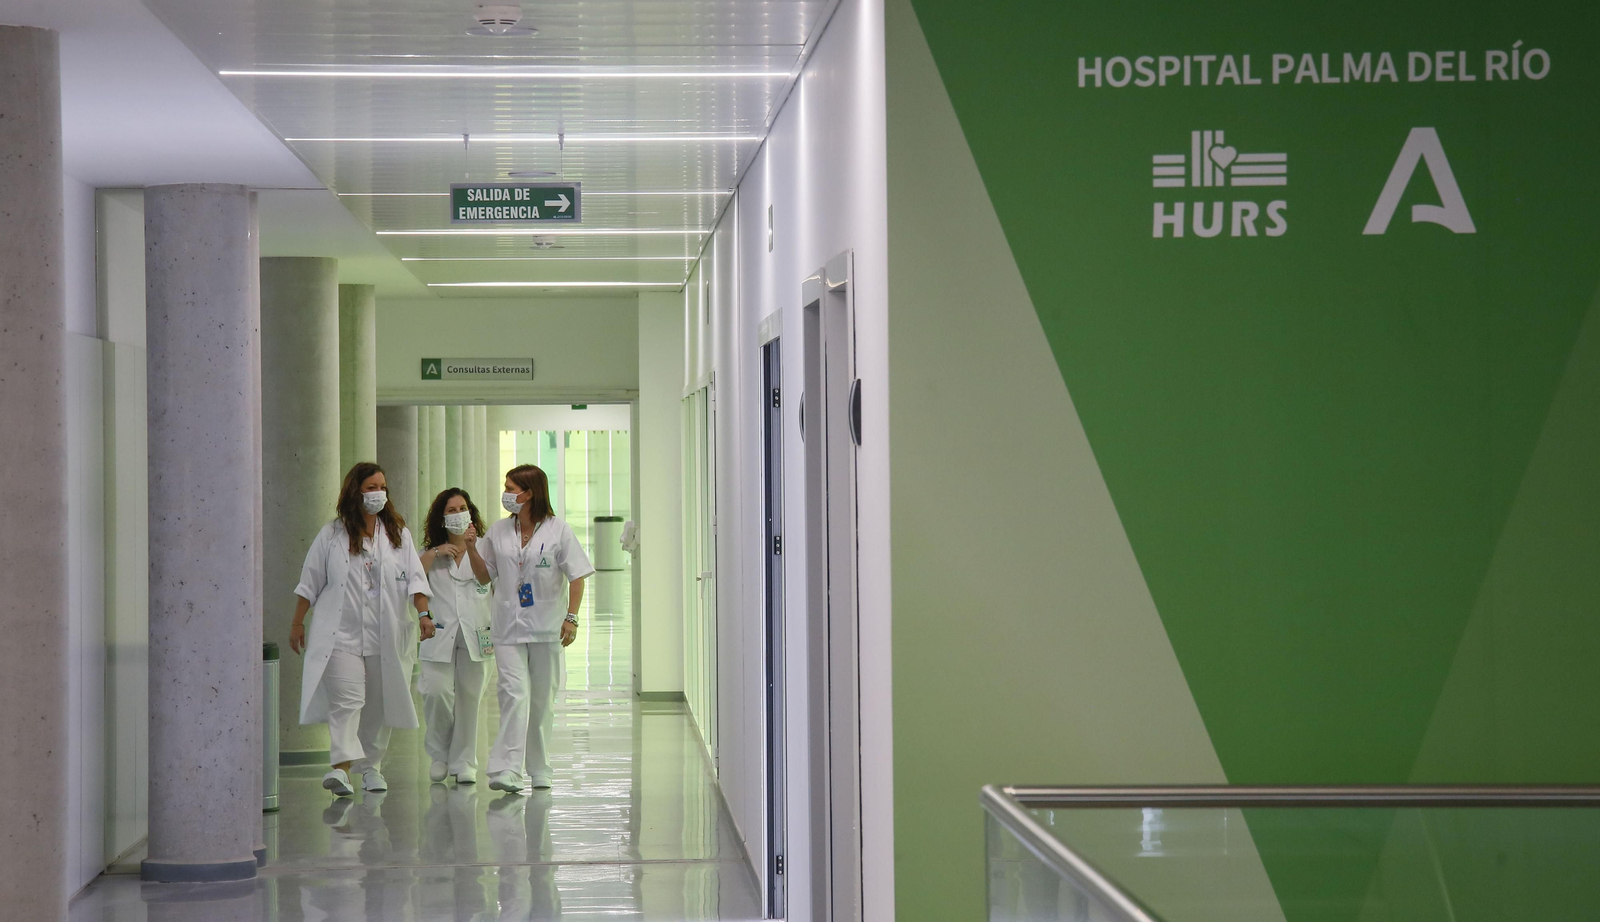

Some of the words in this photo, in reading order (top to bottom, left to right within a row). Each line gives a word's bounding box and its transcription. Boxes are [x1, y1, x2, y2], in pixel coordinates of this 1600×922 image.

[1077, 54, 1262, 89] HOSPITAL
[1271, 51, 1399, 85] PALMA
[1407, 50, 1477, 83] DEL
[1485, 39, 1551, 82] RÍO
[466, 187, 511, 203] SALIDA
[514, 187, 531, 202] DE
[458, 205, 540, 220] EMERGENCIA
[1152, 200, 1288, 239] HURS
[446, 365, 491, 375] Consultas
[492, 365, 531, 375] Externas
